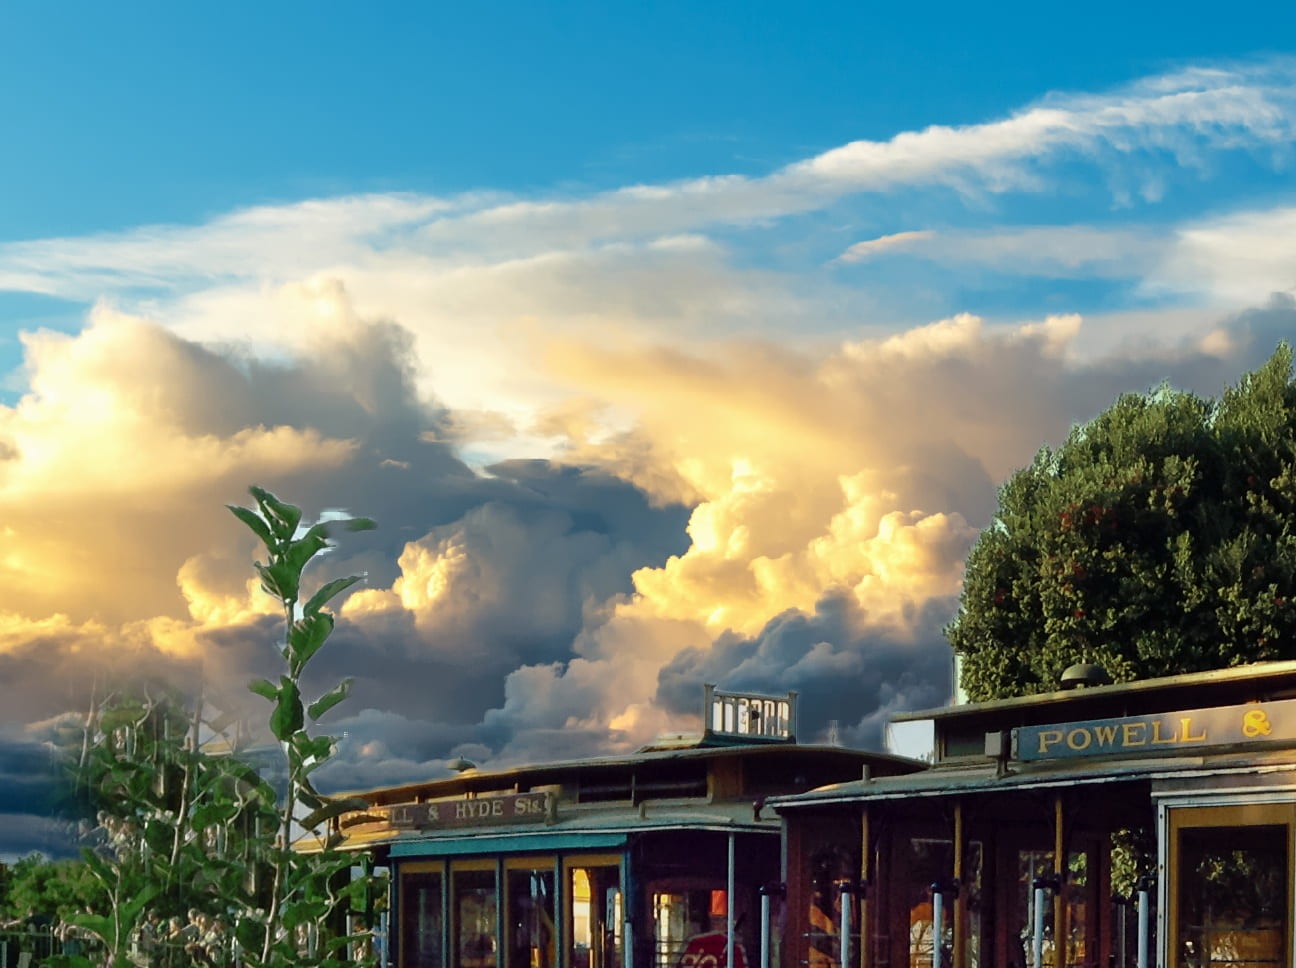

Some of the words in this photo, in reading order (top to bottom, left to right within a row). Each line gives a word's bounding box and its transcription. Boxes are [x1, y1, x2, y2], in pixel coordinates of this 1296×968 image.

[1038, 717, 1208, 754] POWELL
[1242, 709, 1273, 738] &
[428, 805, 440, 821] &
[455, 798, 505, 820] HYDE
